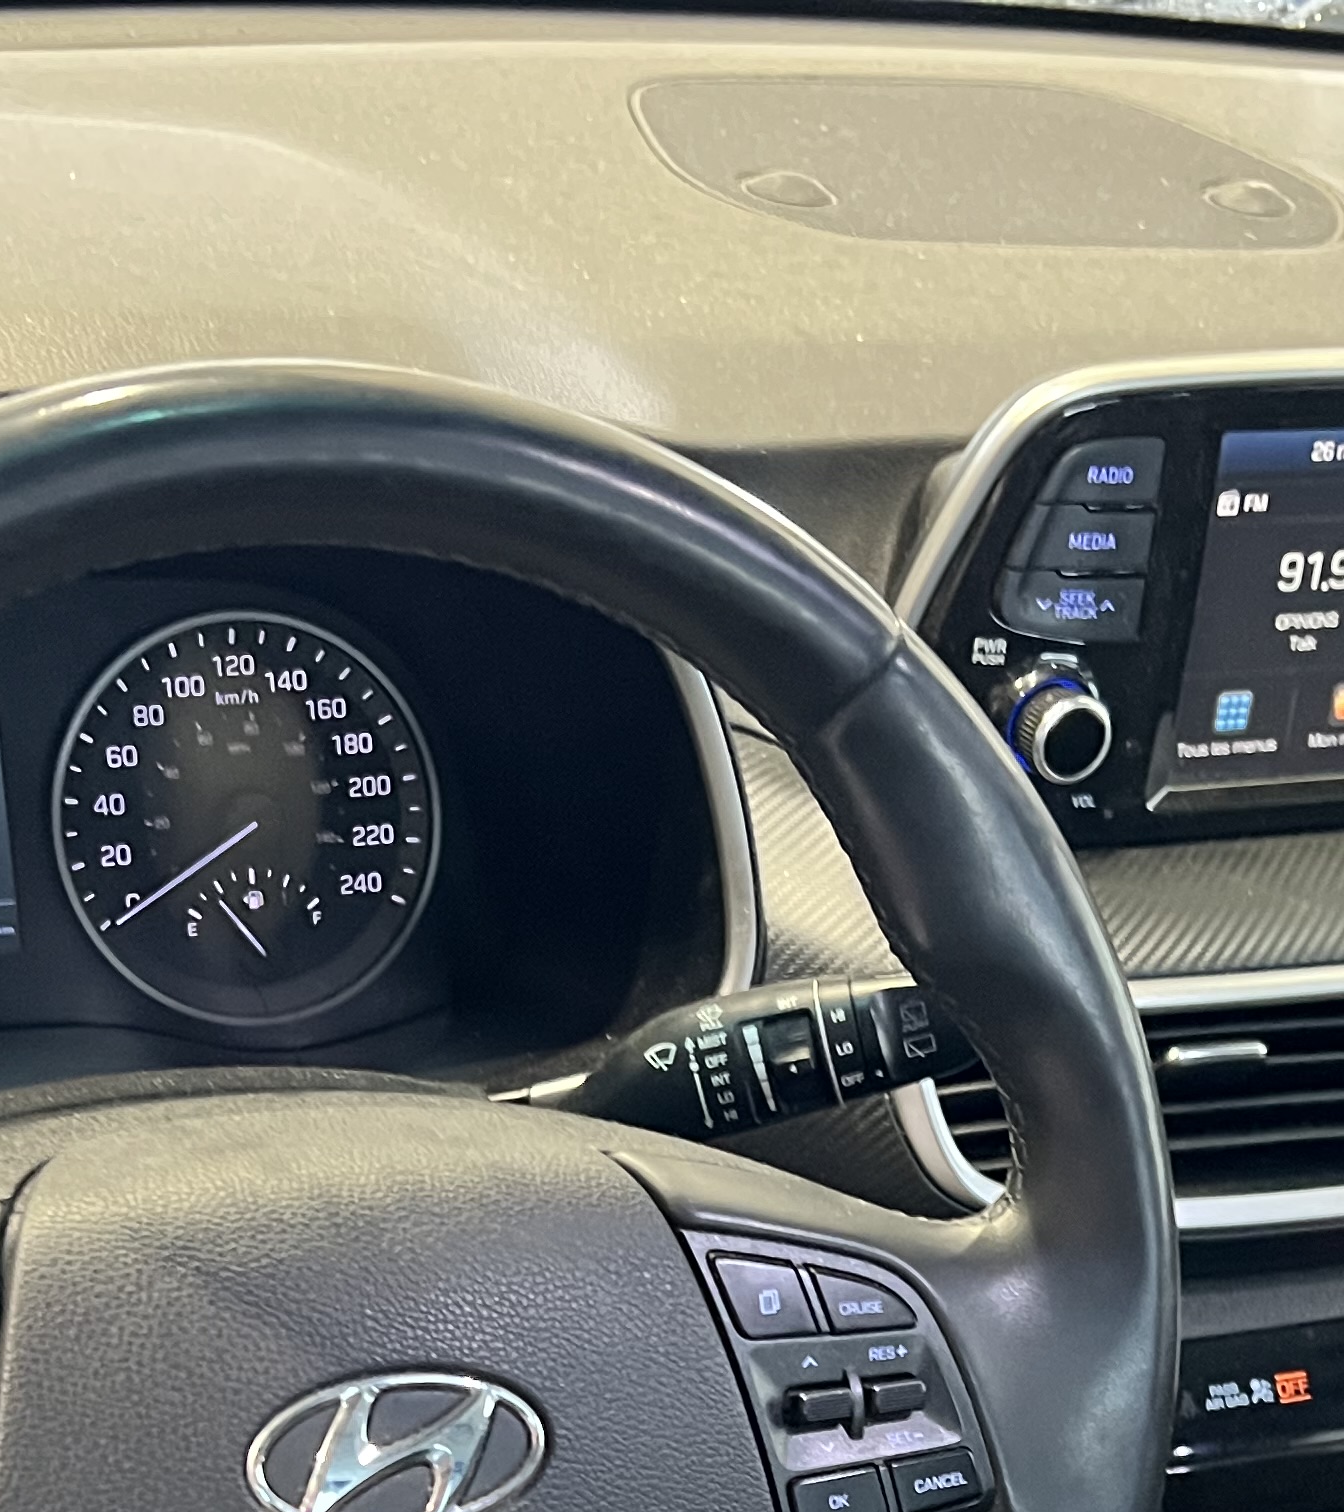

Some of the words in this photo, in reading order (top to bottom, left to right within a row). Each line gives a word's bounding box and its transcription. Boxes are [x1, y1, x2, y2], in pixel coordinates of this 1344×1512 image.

[1087, 466, 1134, 484] RADIO
[1068, 533, 1116, 551] MEDIA
[974, 637, 1007, 655] PWR
[212, 654, 255, 678] 120
[161, 675, 205, 698] 100
[264, 669, 307, 693] 140
[214, 689, 260, 706] km/h
[132, 704, 165, 727] 80
[305, 698, 347, 720] 160
[331, 732, 373, 755] 180
[105, 745, 138, 768] 60
[348, 775, 391, 798] 200
[93, 793, 126, 816] 40
[352, 823, 395, 848] 220
[100, 844, 132, 867] 20
[339, 872, 382, 895] 240
[311, 910, 322, 925] F
[187, 922, 199, 937] E
[776, 995, 798, 1011] INT
[830, 1007, 847, 1024] HI
[835, 1040, 855, 1057] LO
[704, 1051, 729, 1070] OFF
[710, 1070, 732, 1088] INT
[840, 1070, 865, 1088] OFF
[716, 1090, 736, 1105] LO
[838, 1299, 884, 1317] CRUISE
[1275, 1379, 1309, 1399] OFF
[913, 1471, 969, 1495] CANCEL
[827, 1493, 851, 1511] OK
